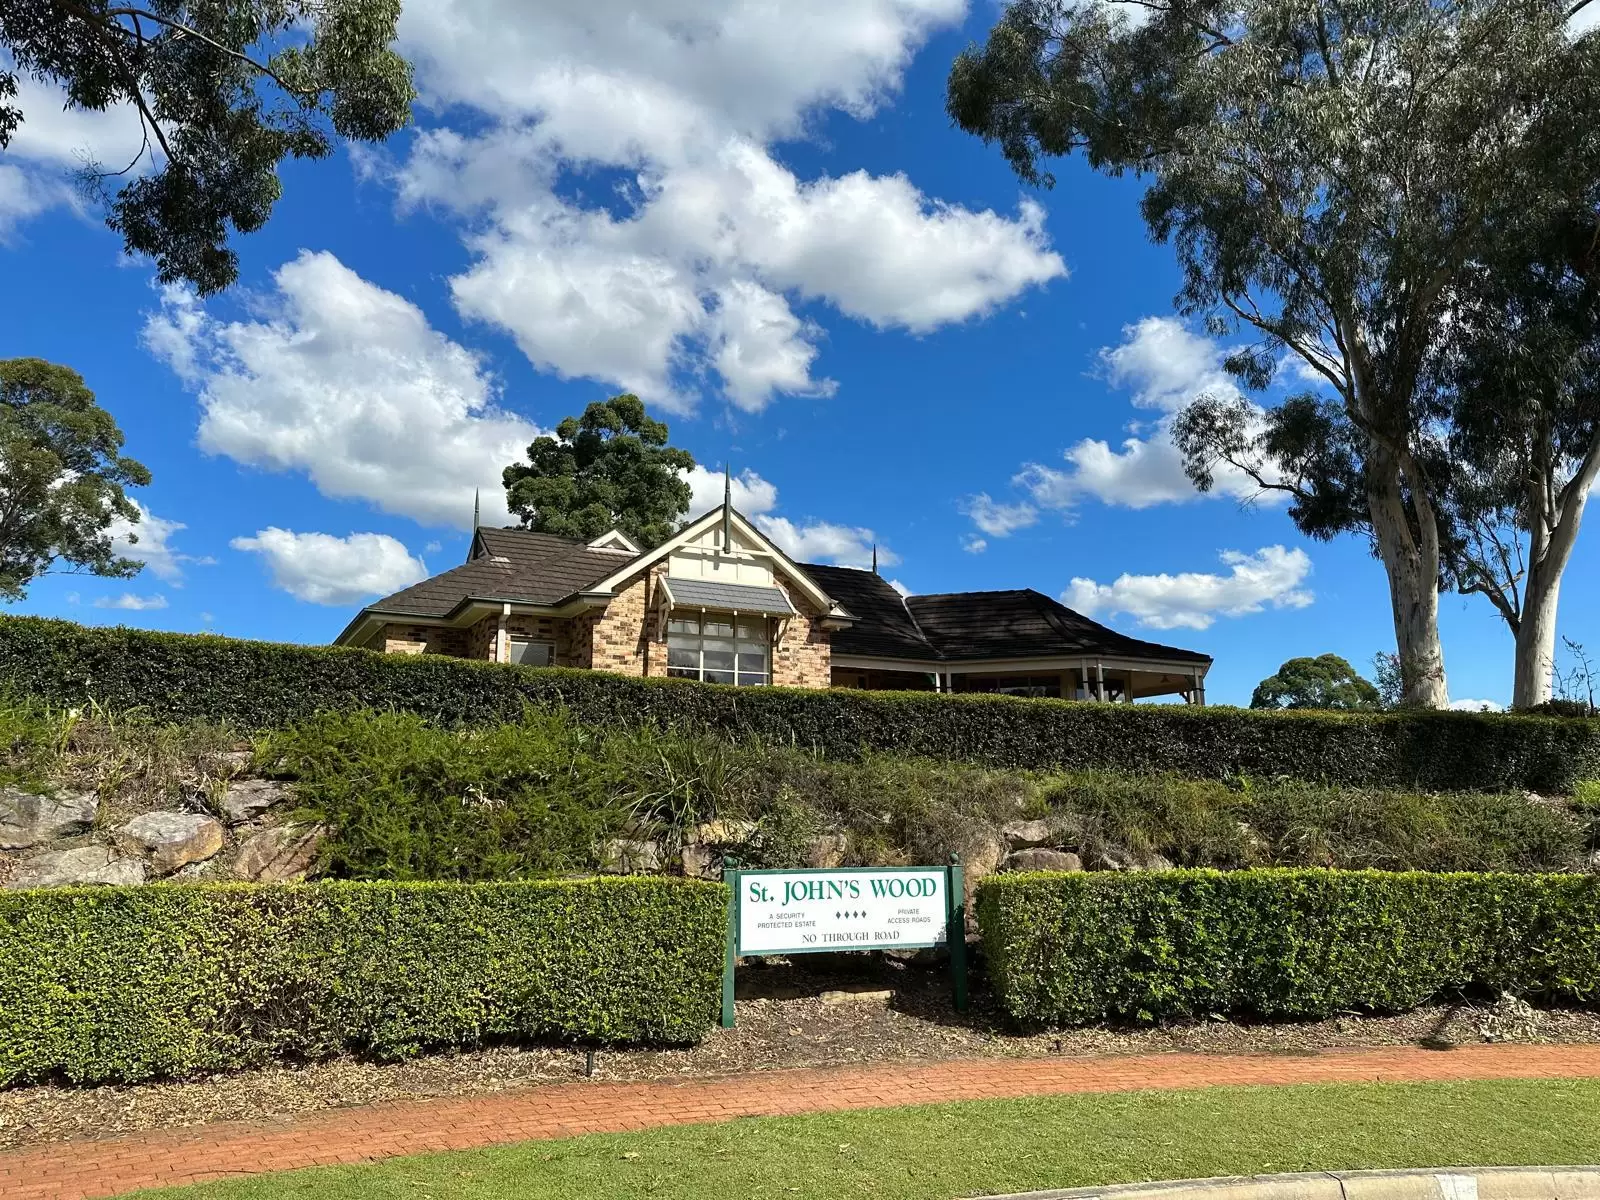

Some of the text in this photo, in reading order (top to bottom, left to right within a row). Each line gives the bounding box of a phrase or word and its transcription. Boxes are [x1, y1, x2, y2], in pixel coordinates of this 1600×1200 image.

[749, 878, 937, 906] St. JOHN'S WOOD
[776, 912, 805, 920] SECURITY
[757, 920, 816, 929] PROTECTED ESTATE
[802, 930, 900, 943] NO THROUGH ROAD
